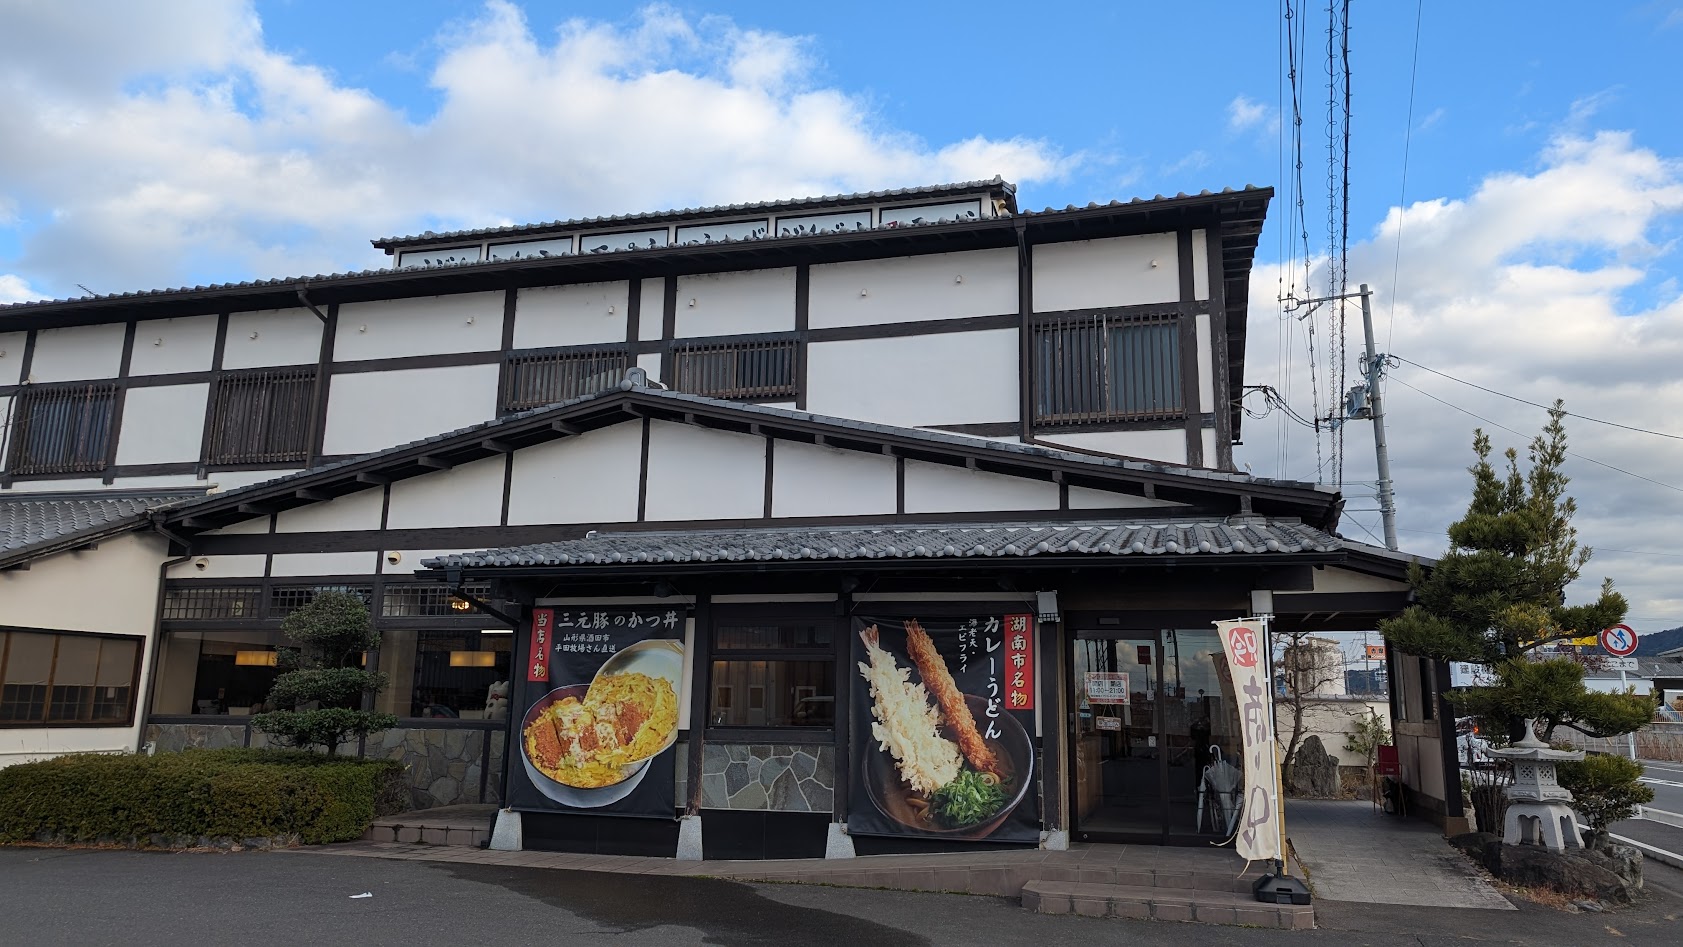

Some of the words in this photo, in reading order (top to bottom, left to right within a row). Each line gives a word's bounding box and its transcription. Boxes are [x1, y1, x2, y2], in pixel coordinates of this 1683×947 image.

[533, 612, 547, 678] 当店名物
[558, 610, 679, 630] 三元豚のかつ丼
[562, 632, 611, 643] 山形県酒田市
[554, 643, 617, 654] 平田牧場さん直送
[957, 624, 968, 674] エビフライ
[1010, 616, 1028, 708] 湖南市名物
[984, 615, 1003, 740] カレーうどん
